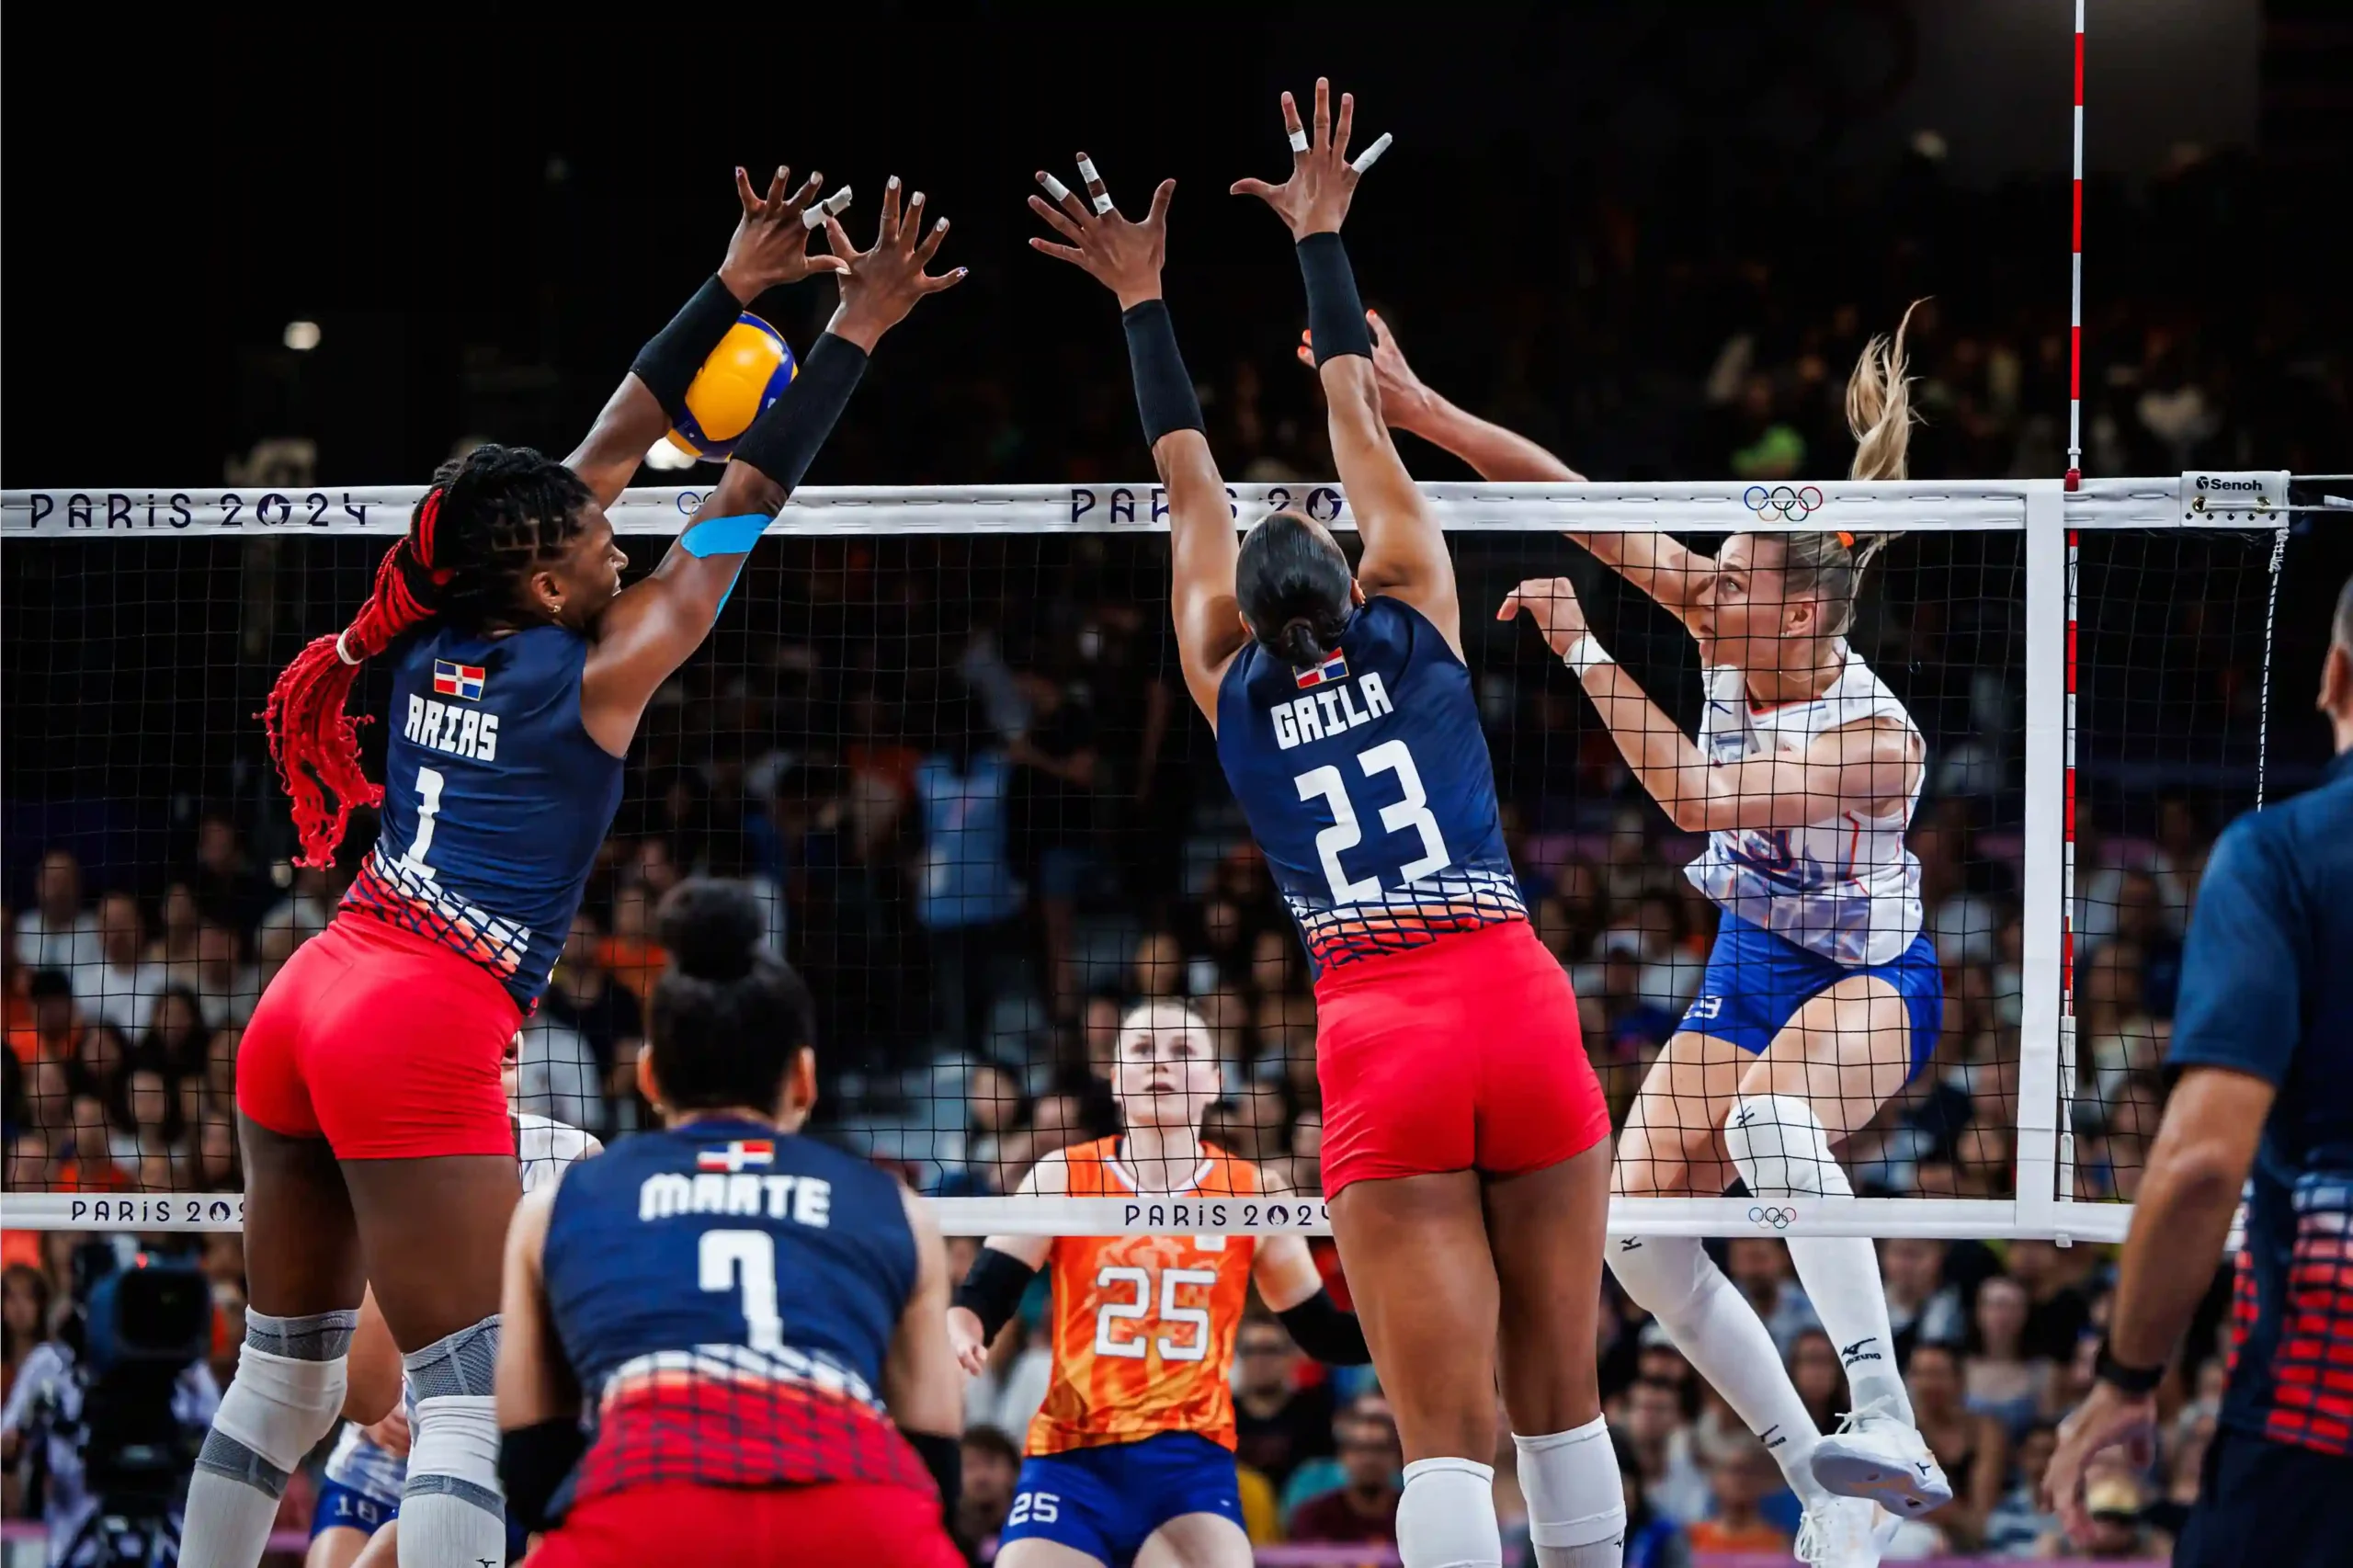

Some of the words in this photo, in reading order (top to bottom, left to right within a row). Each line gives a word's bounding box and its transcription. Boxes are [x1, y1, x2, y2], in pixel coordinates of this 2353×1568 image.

[221, 492, 366, 528] 2024
[1071, 487, 1238, 523] PAR
[2211, 478, 2263, 491] Senoh
[404, 693, 499, 762] ARIAS
[1270, 671, 1393, 750] GAILA
[399, 766, 444, 880] 1
[1293, 739, 1451, 905] 23
[639, 1173, 831, 1229] MARTE
[699, 1229, 784, 1353] 7
[1095, 1266, 1216, 1361] 25
[1008, 1493, 1060, 1527] 25
